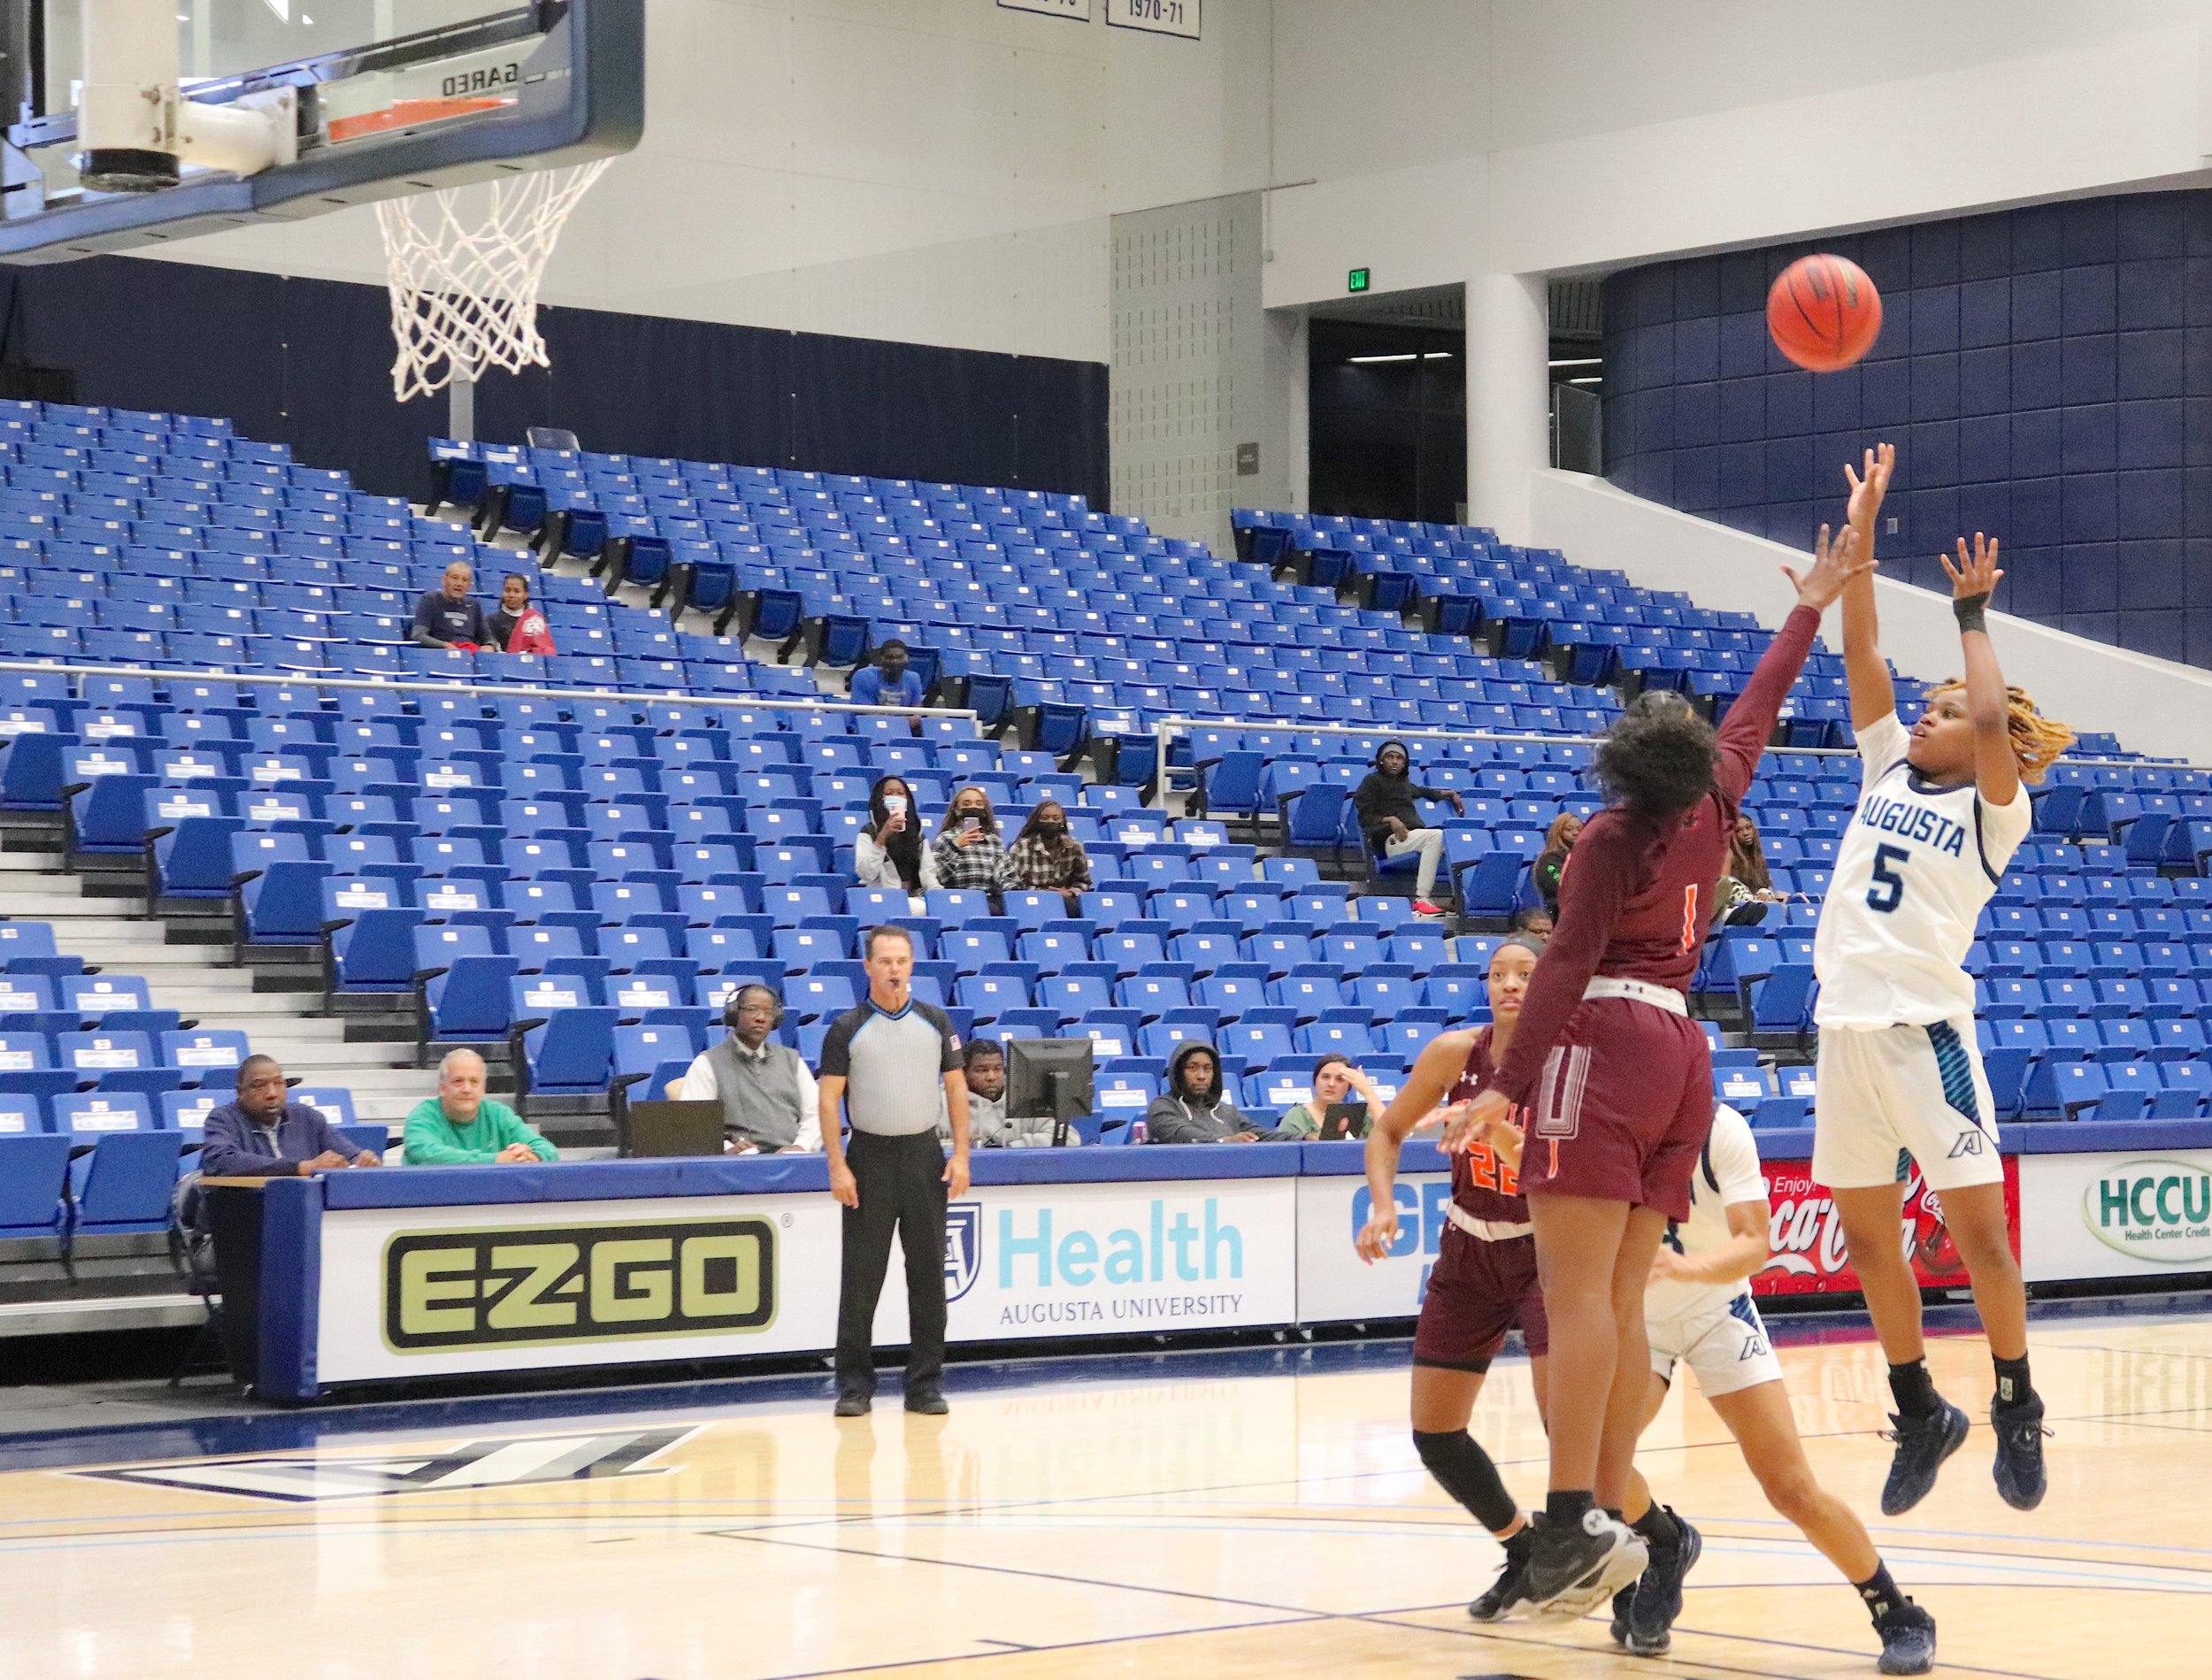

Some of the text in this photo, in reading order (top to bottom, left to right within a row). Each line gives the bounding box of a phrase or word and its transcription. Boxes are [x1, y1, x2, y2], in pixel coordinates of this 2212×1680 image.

[1129, 0, 1183, 24] 1970-71
[1858, 794, 1965, 858] AUGUSTA
[1864, 841, 1911, 914] 5
[1676, 883, 1698, 957] 1
[1773, 1176, 1817, 1196] Enjoy!
[2100, 1175, 2210, 1227] HCCU
[999, 1198, 1243, 1288] Health
[2124, 1225, 2210, 1241] Health Center Credit
[400, 1234, 760, 1335] EZGO
[1000, 1294, 1243, 1324] AUGUSTA UNIVERSITY
